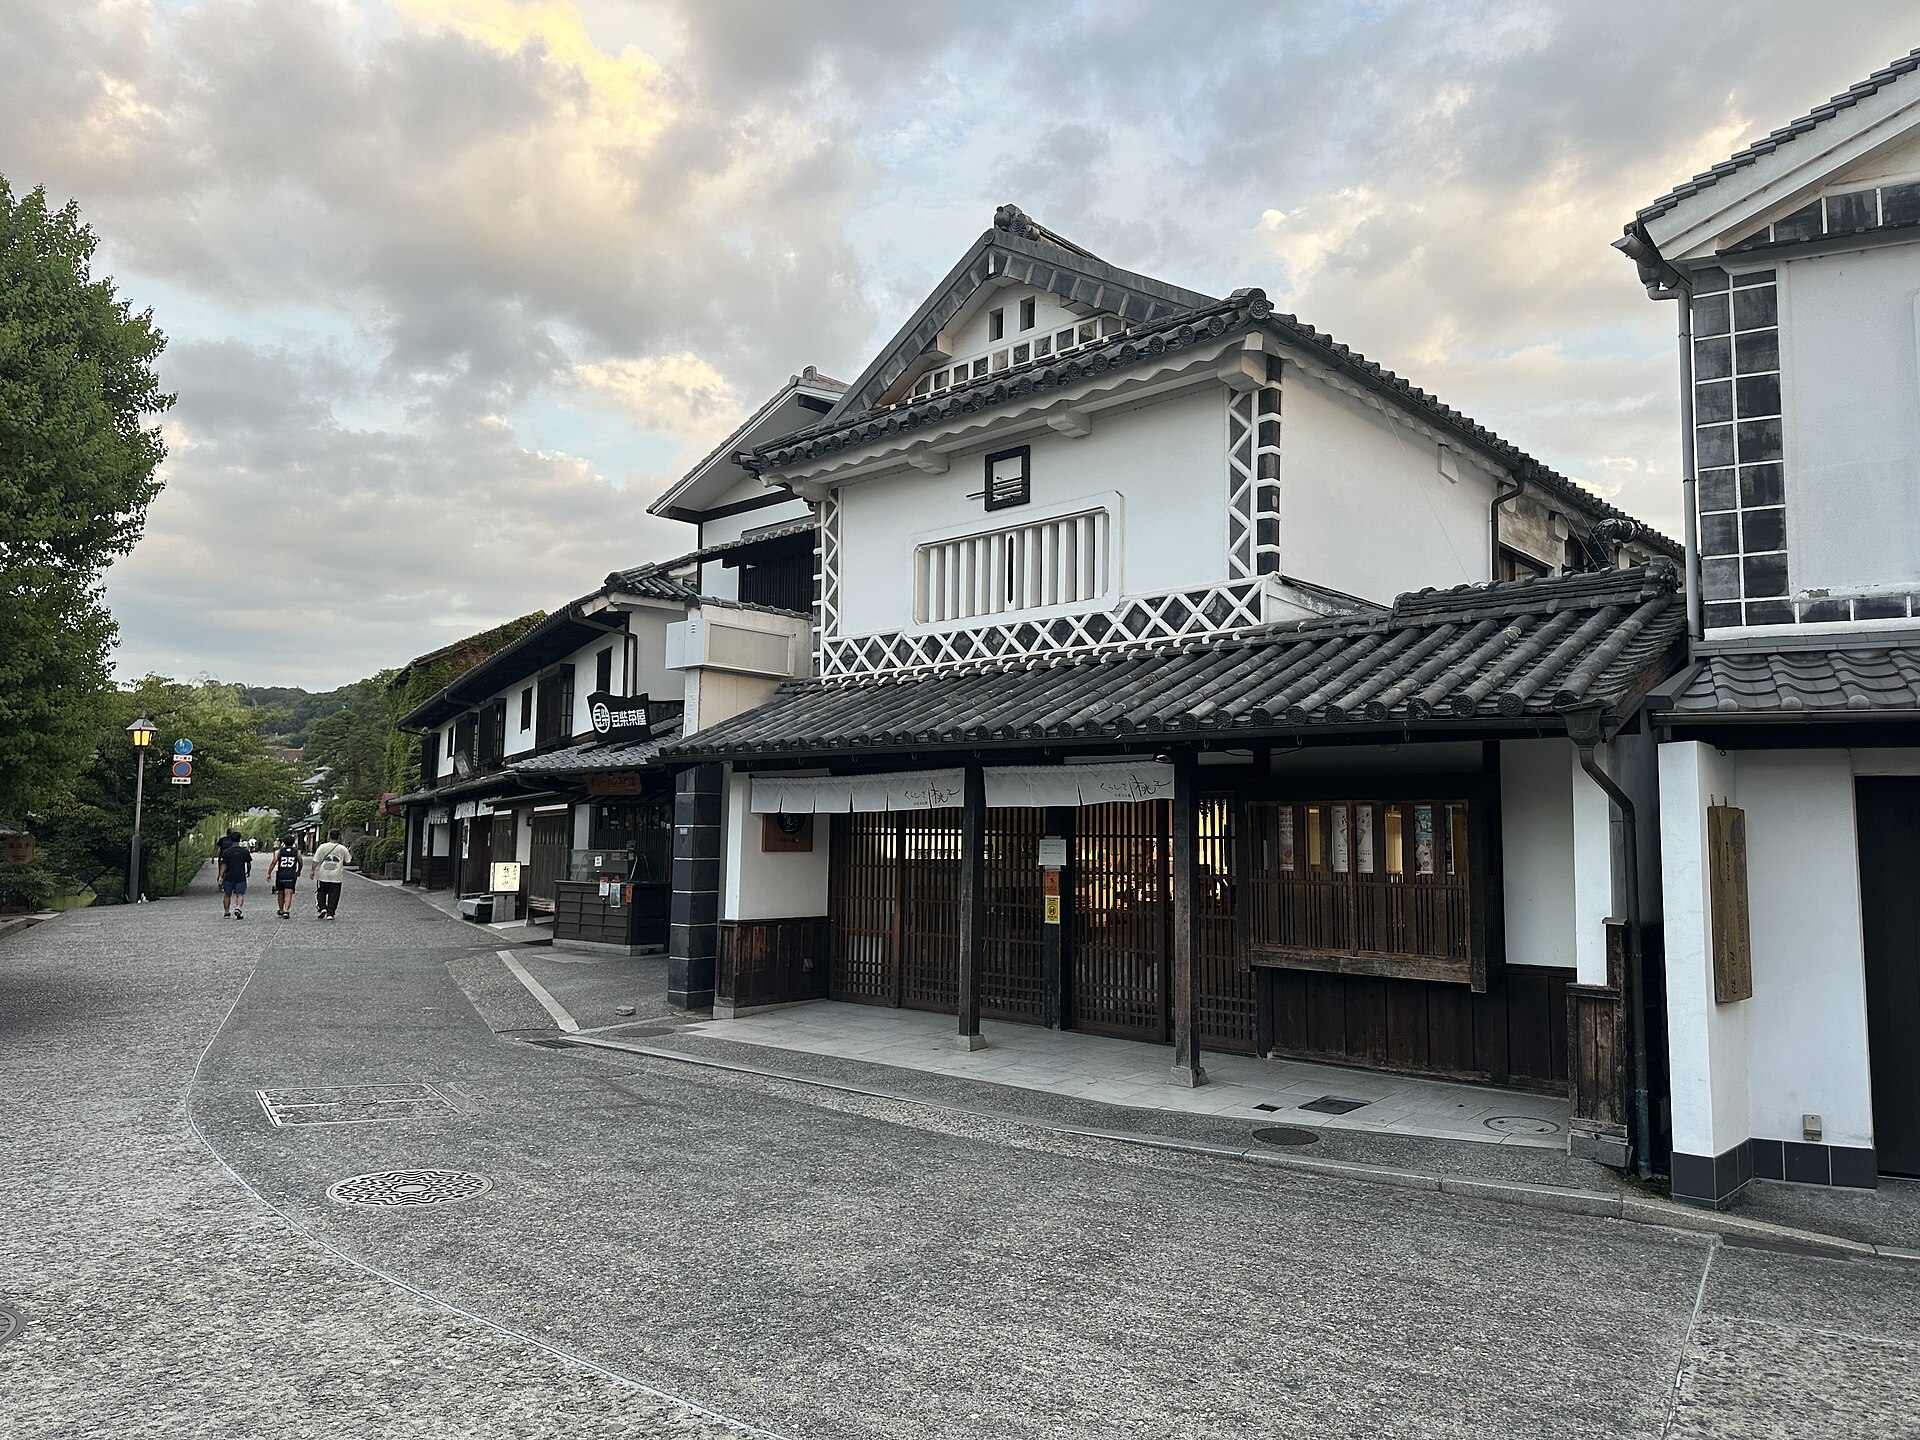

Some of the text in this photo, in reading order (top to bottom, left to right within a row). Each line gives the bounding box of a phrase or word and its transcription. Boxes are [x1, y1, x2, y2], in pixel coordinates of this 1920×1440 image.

[610, 709, 647, 728] 豆柴茶屋
[280, 857, 296, 868] 25
